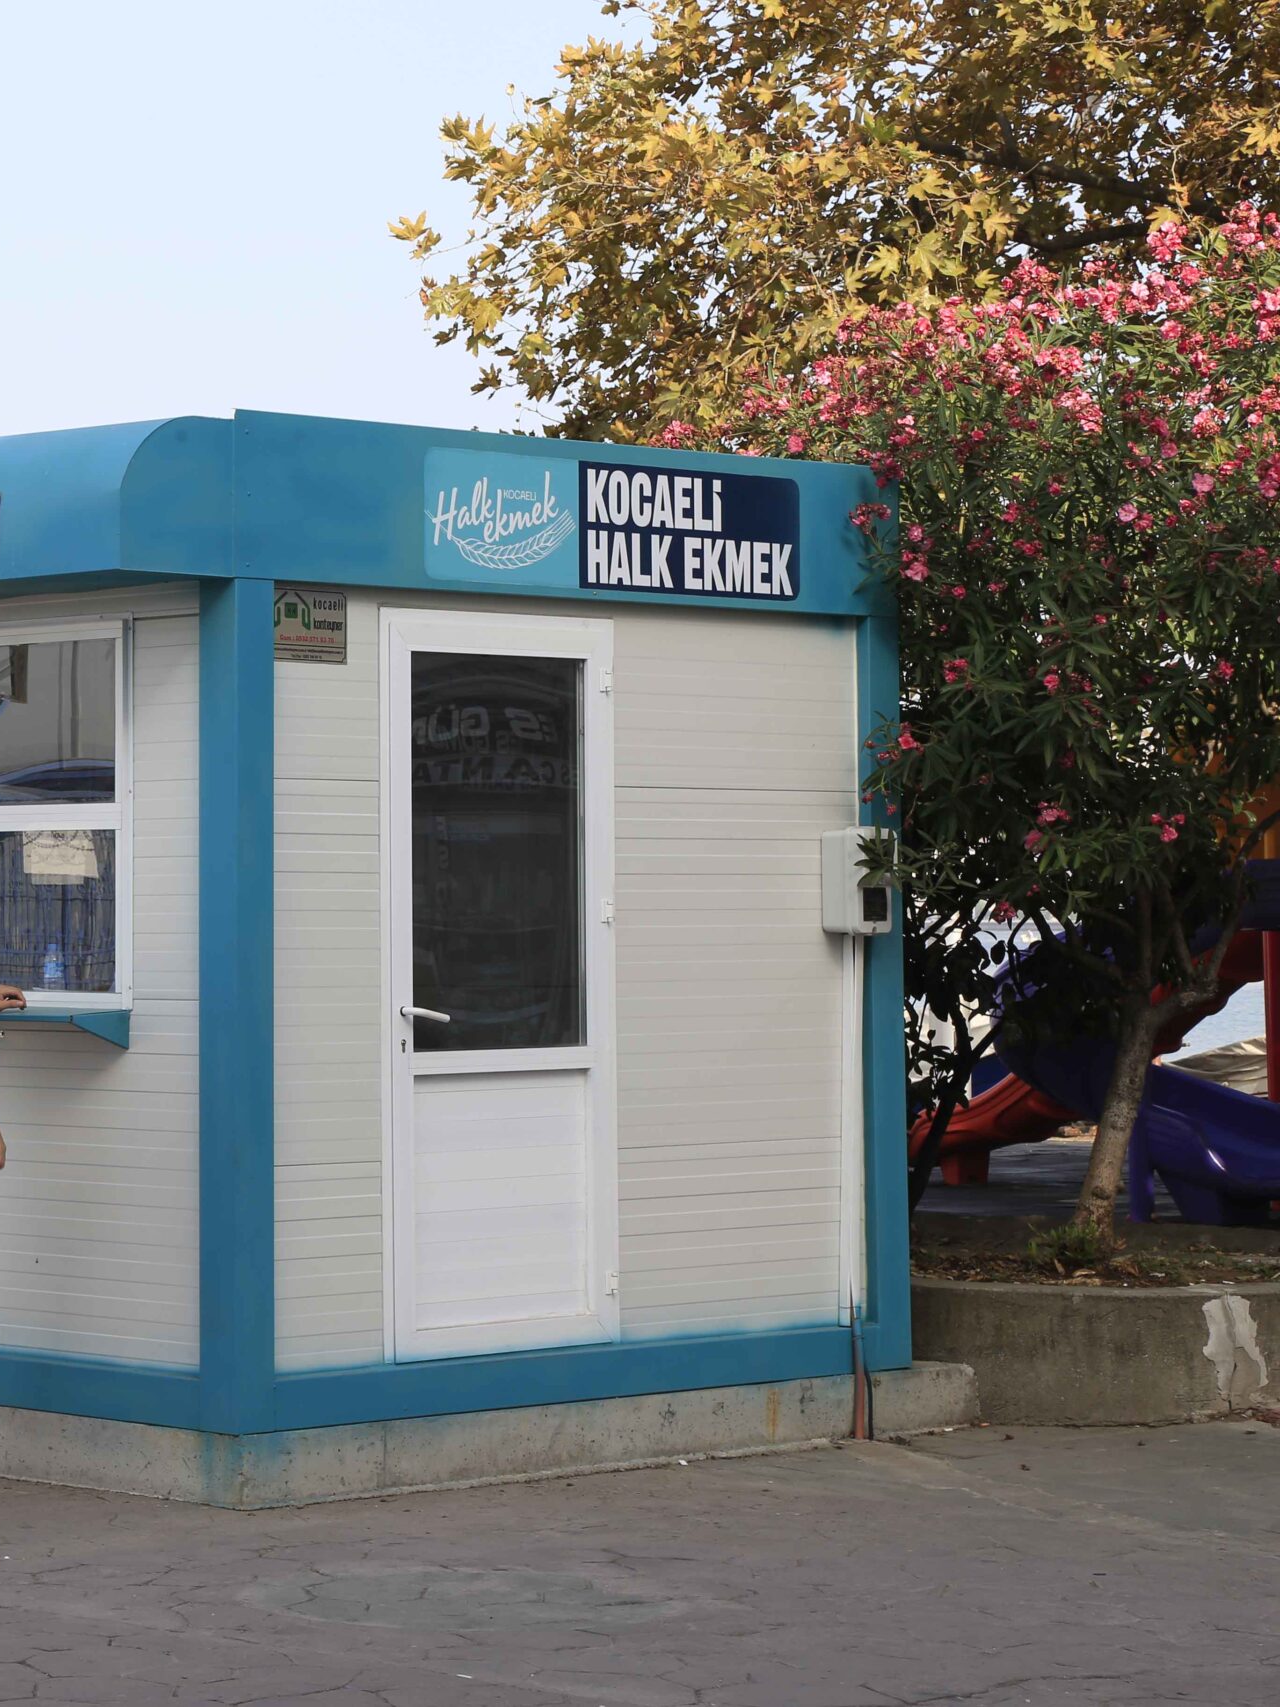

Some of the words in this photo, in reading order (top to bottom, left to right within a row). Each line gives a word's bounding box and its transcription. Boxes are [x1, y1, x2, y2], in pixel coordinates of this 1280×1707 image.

[432, 477, 495, 546] Halk
[587, 529, 674, 589] HALK
[683, 536, 794, 596] EKMEK
